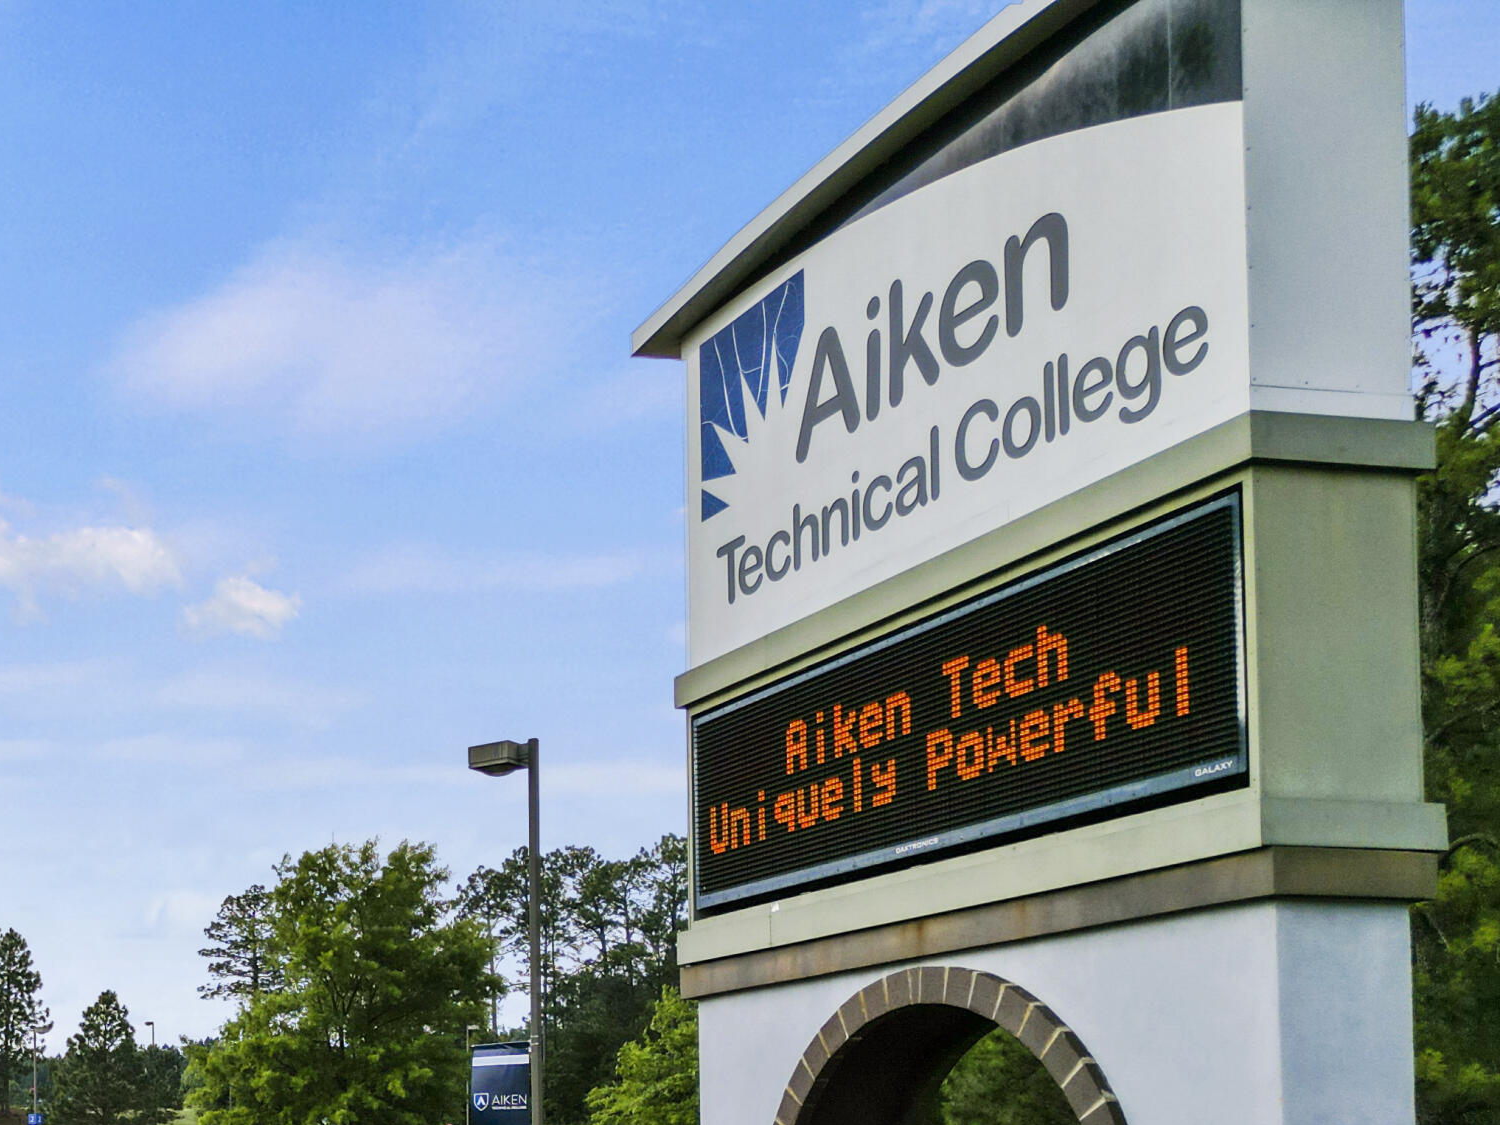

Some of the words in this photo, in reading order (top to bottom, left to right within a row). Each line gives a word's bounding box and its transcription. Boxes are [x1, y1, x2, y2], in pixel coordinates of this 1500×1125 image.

[796, 212, 1070, 463] Aiken
[716, 425, 940, 605] Technical
[955, 306, 1209, 482] College
[710, 757, 897, 855] Uniquely
[926, 647, 1190, 790] Powerful
[786, 691, 912, 774] Aiken
[943, 625, 1069, 718] Tech
[1194, 760, 1233, 777] GALAXY
[491, 1094, 527, 1105] AIKEN
